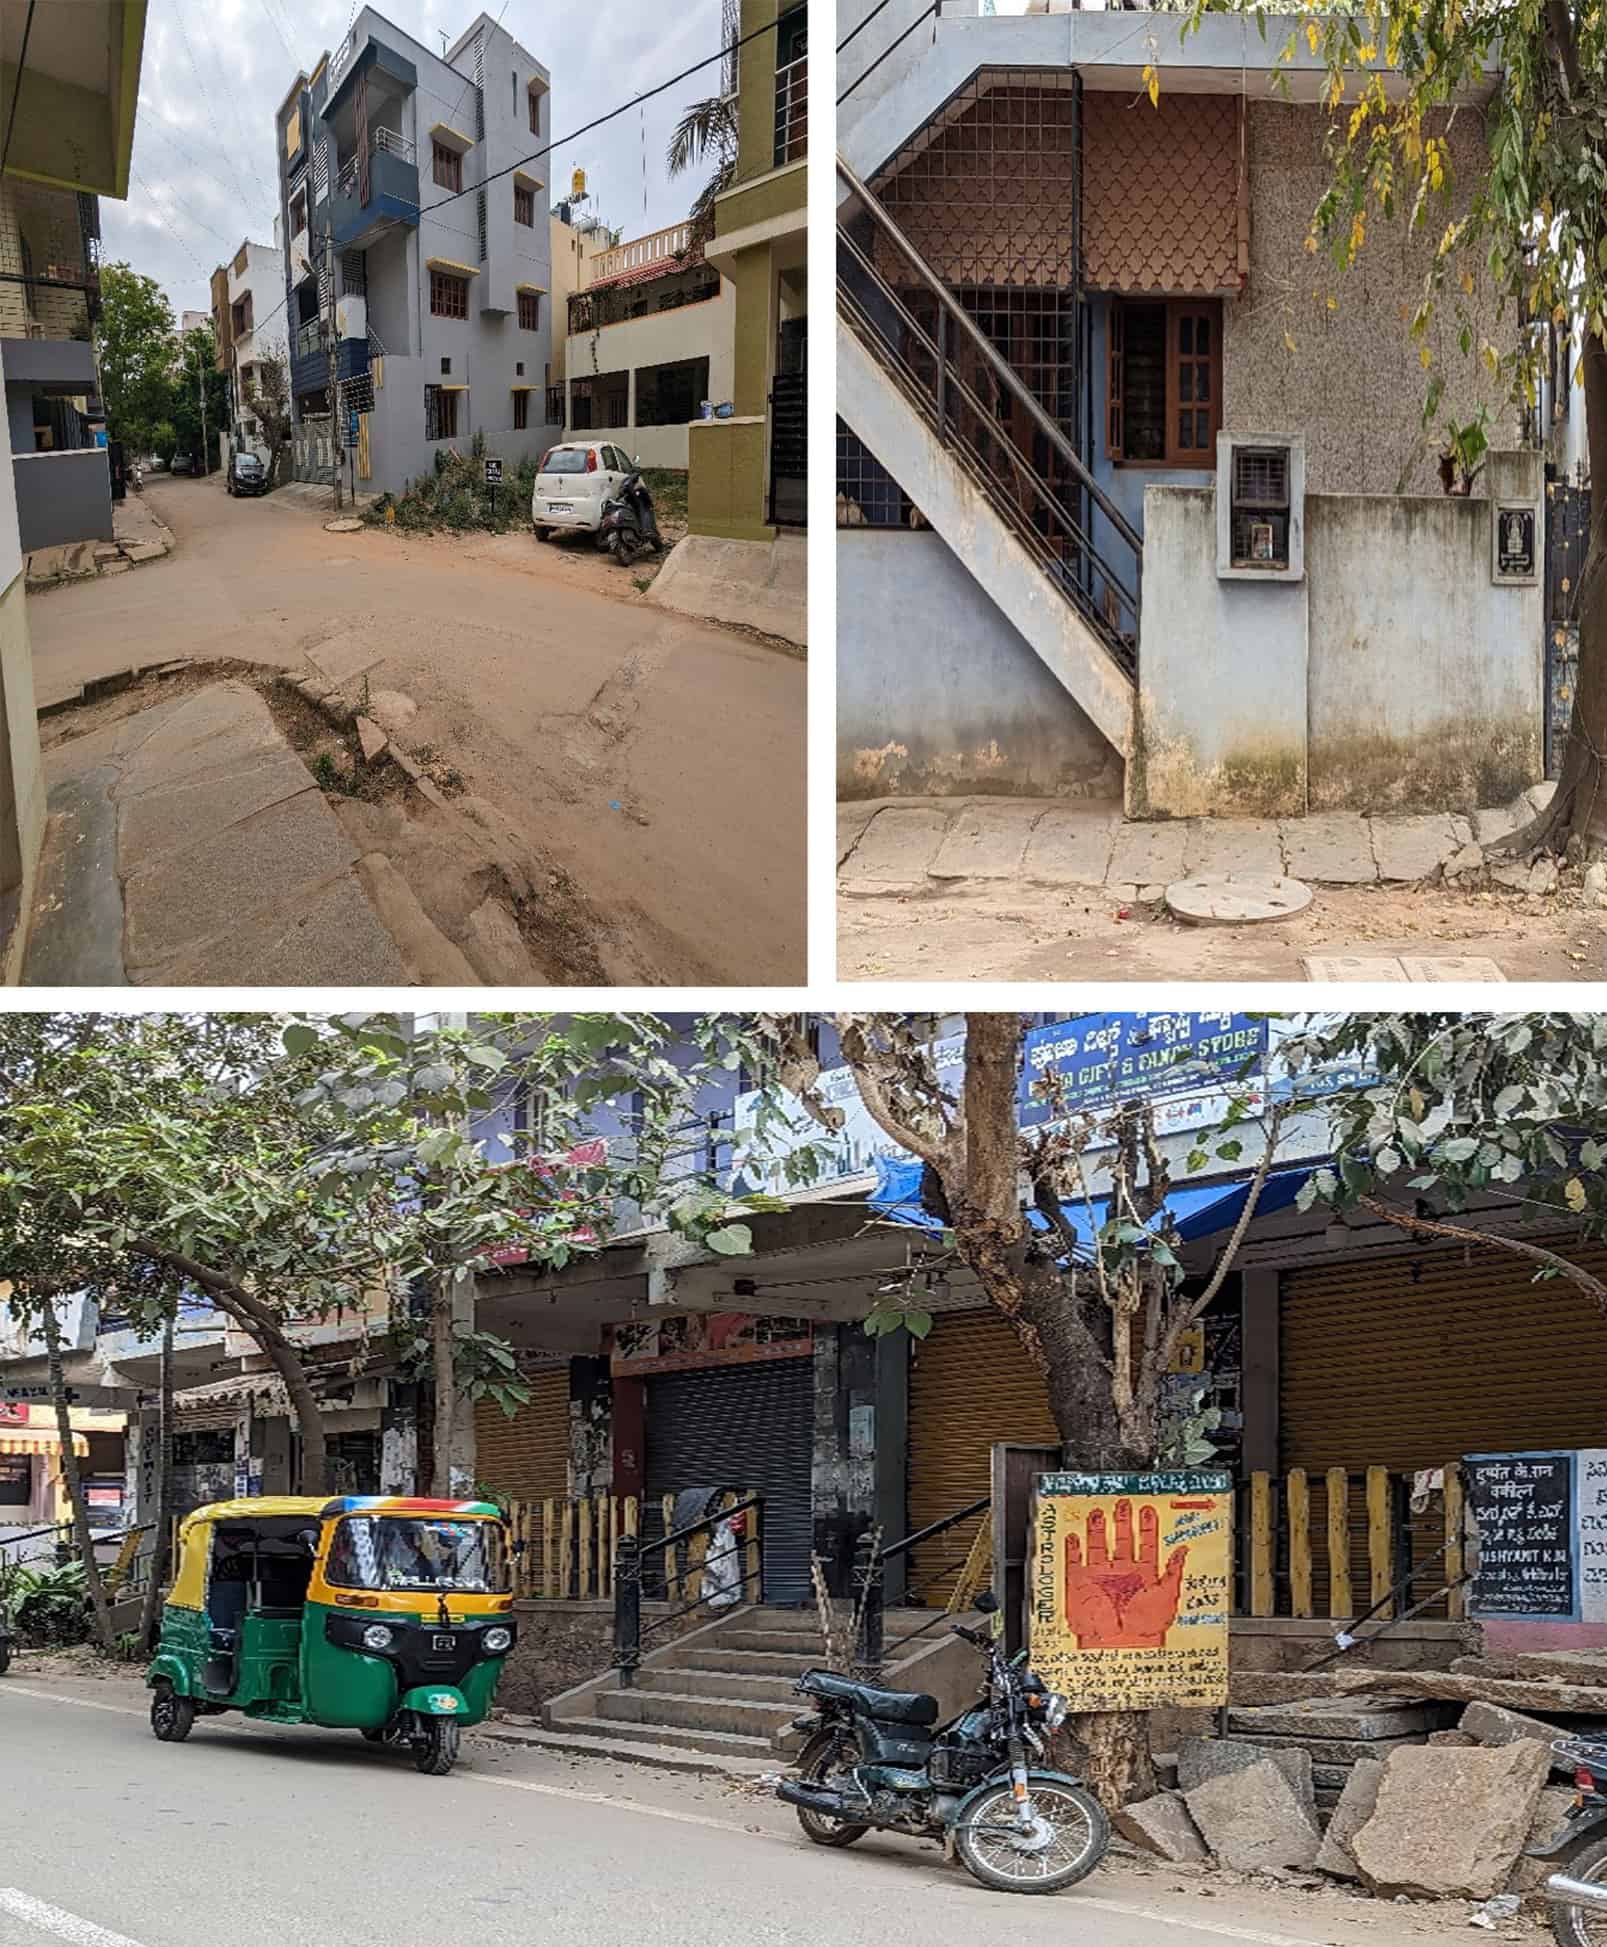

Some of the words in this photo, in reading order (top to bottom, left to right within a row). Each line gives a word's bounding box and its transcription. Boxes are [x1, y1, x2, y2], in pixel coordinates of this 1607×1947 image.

[1078, 1059, 1118, 1085] GIFT
[1198, 1027, 1260, 1057] STORE
[1037, 1504, 1056, 1624] ASTROLOGER
